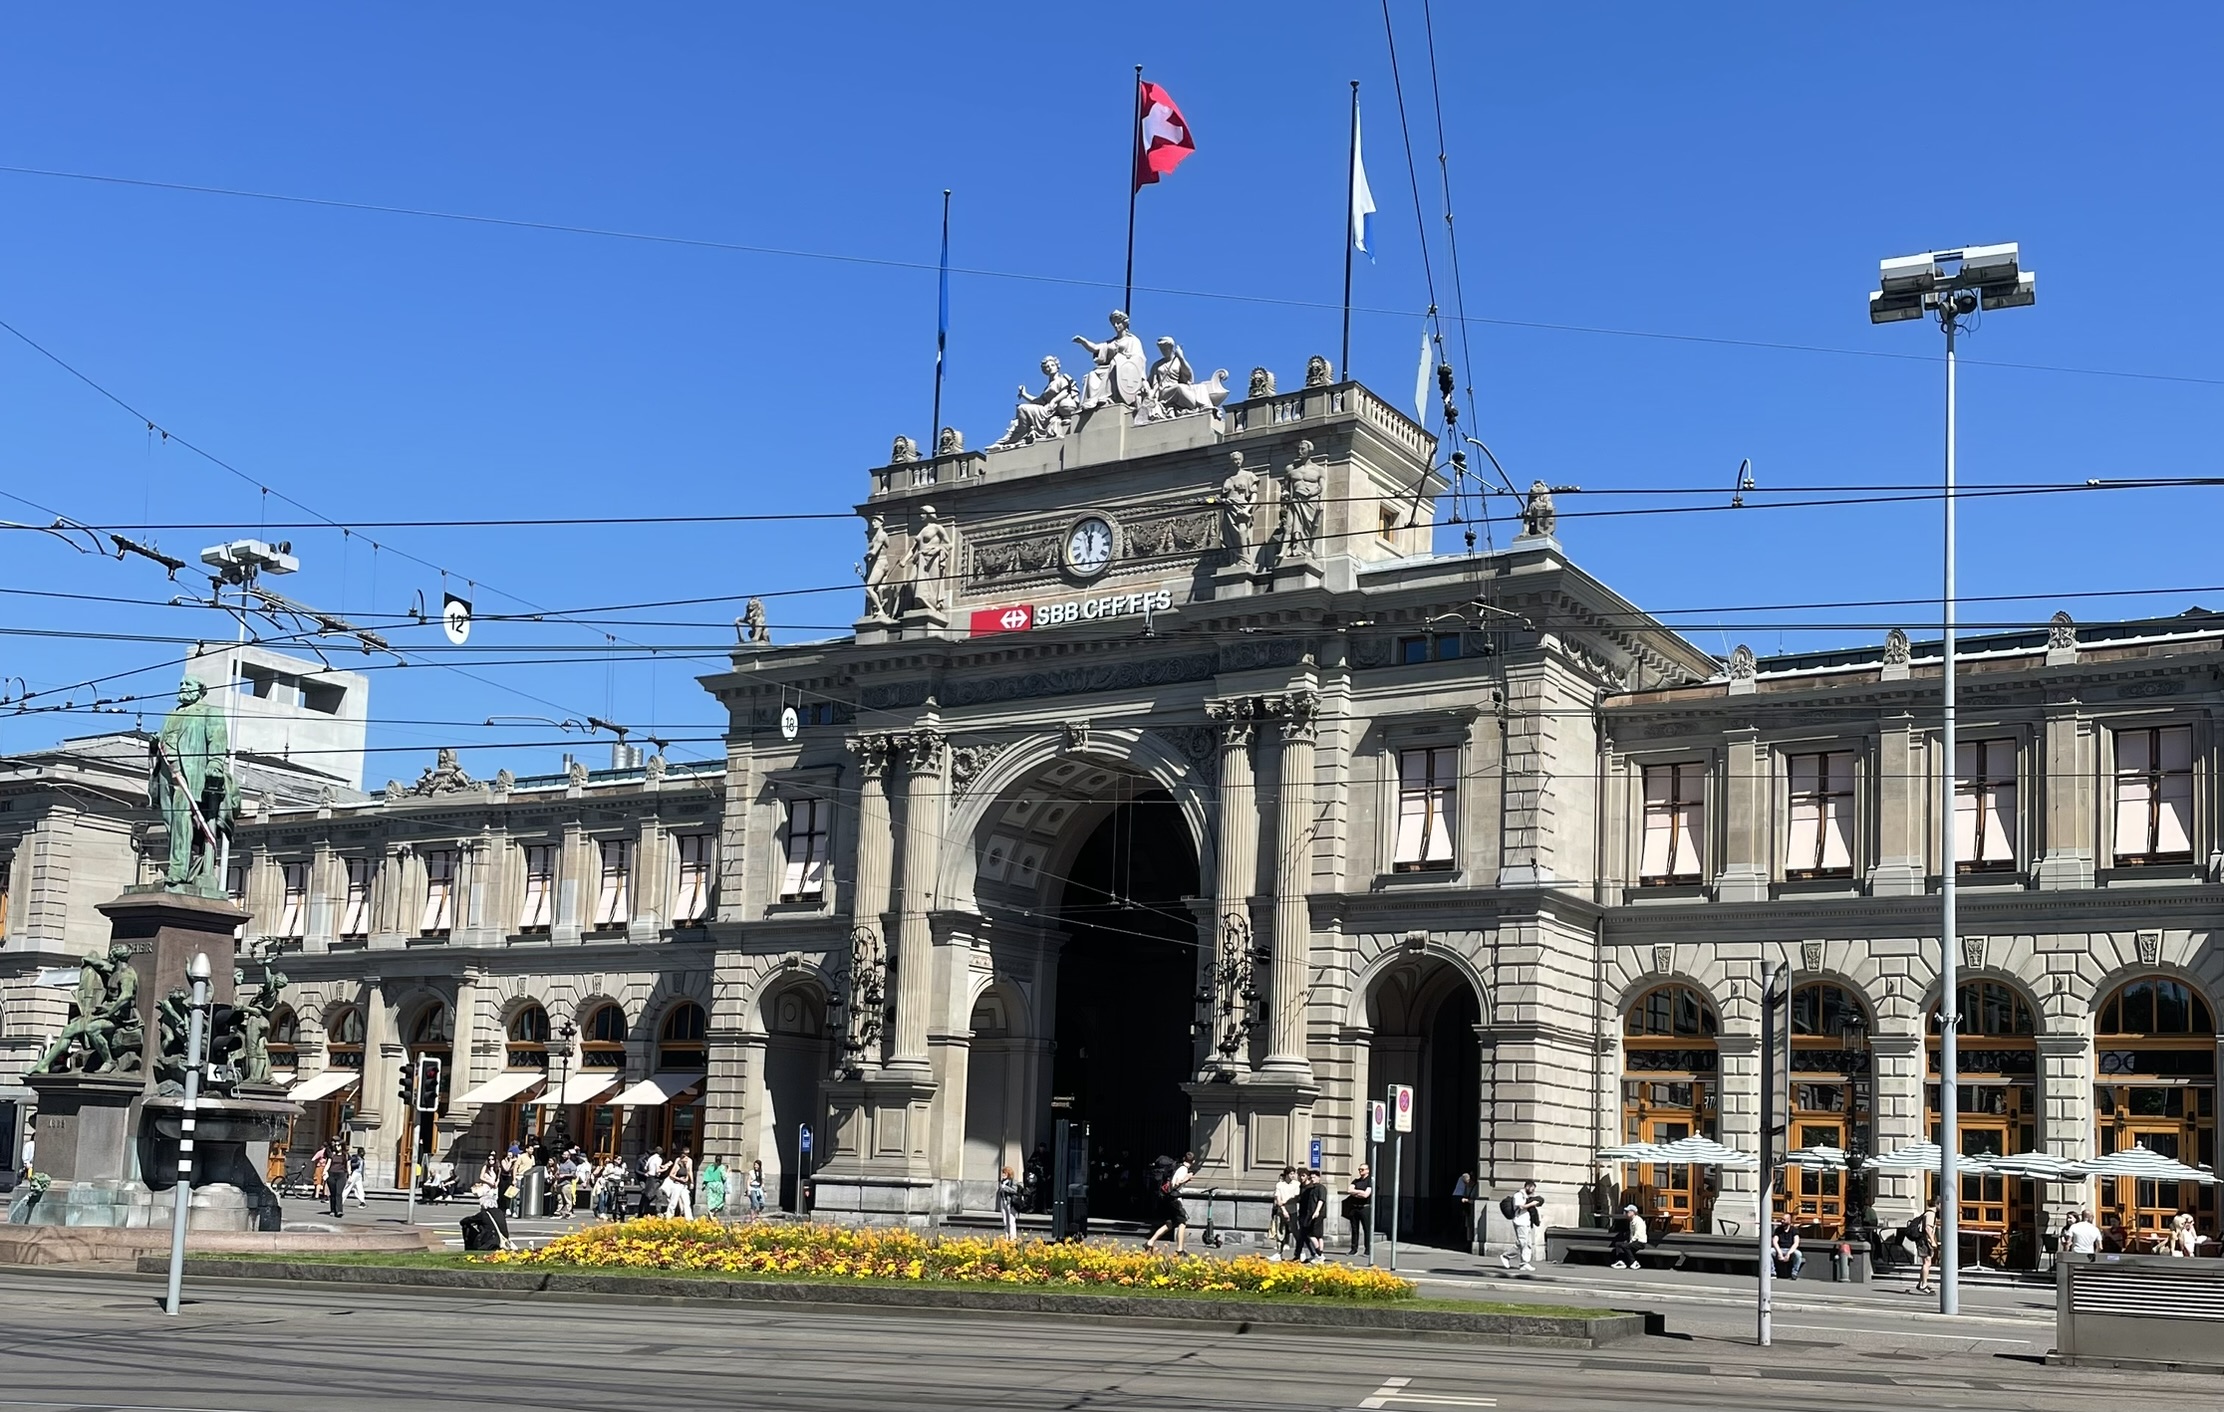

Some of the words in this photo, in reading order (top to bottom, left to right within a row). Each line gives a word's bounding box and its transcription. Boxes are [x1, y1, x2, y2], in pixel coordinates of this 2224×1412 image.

[1036, 601, 1079, 625] SBB
[1084, 596, 1125, 618] CFF
[1129, 589, 1171, 614] FFS
[450, 612, 464, 634] 12
